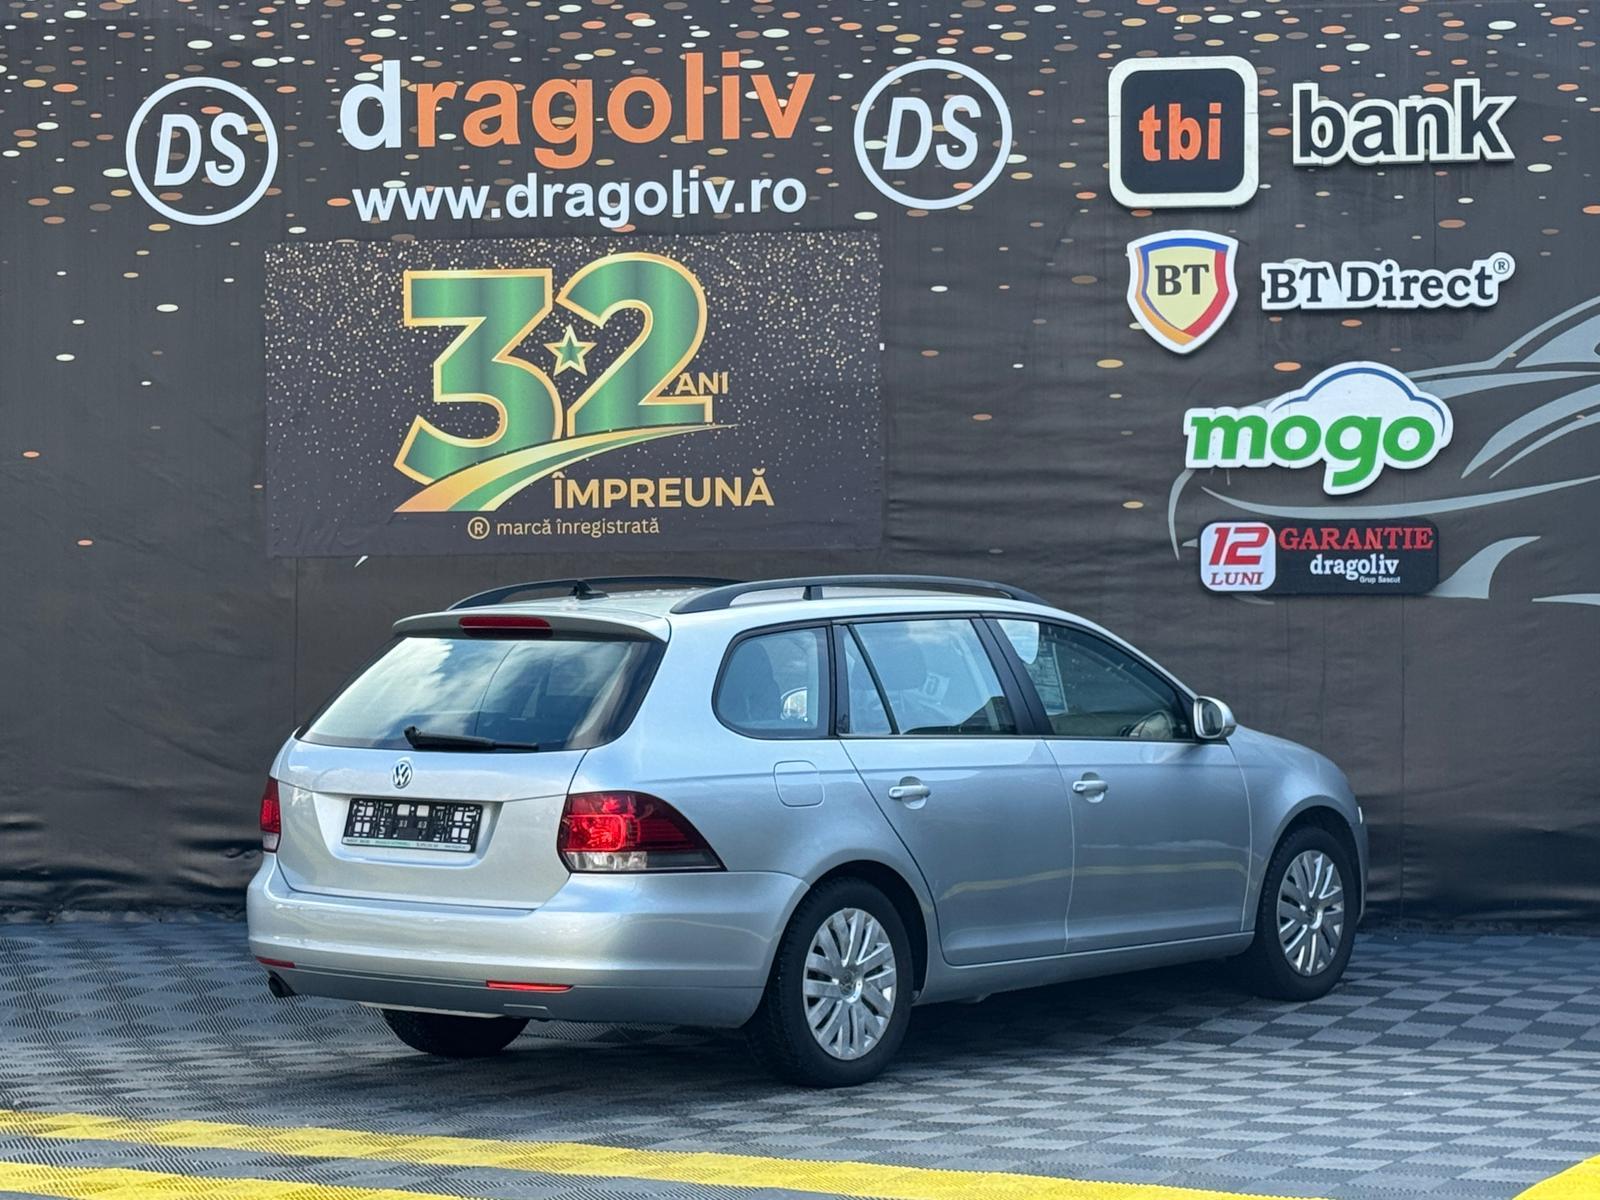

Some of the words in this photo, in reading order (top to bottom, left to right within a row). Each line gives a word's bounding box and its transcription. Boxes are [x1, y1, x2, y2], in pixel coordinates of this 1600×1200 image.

[340, 51, 815, 169] dragoliv
[1139, 103, 1222, 161] tbi
[1297, 82, 1511, 163] bank
[154, 113, 249, 187] DS
[883, 95, 982, 171] DS
[352, 169, 807, 228] www.dragoliv.ro
[1154, 263, 1209, 295] BT
[1267, 267, 1330, 302] BT
[394, 252, 713, 485] 32
[674, 372, 729, 395] ANI
[1191, 414, 1436, 487] mogo
[552, 468, 775, 509] ÎMPREUNĂ
[497, 519, 552, 535] marcă
[556, 517, 660, 538] înregistrată
[1209, 527, 1269, 566] 12
[1279, 527, 1434, 549] GARANTIE
[1210, 572, 1263, 586] LUNI
[1310, 554, 1399, 580] dragoliv
